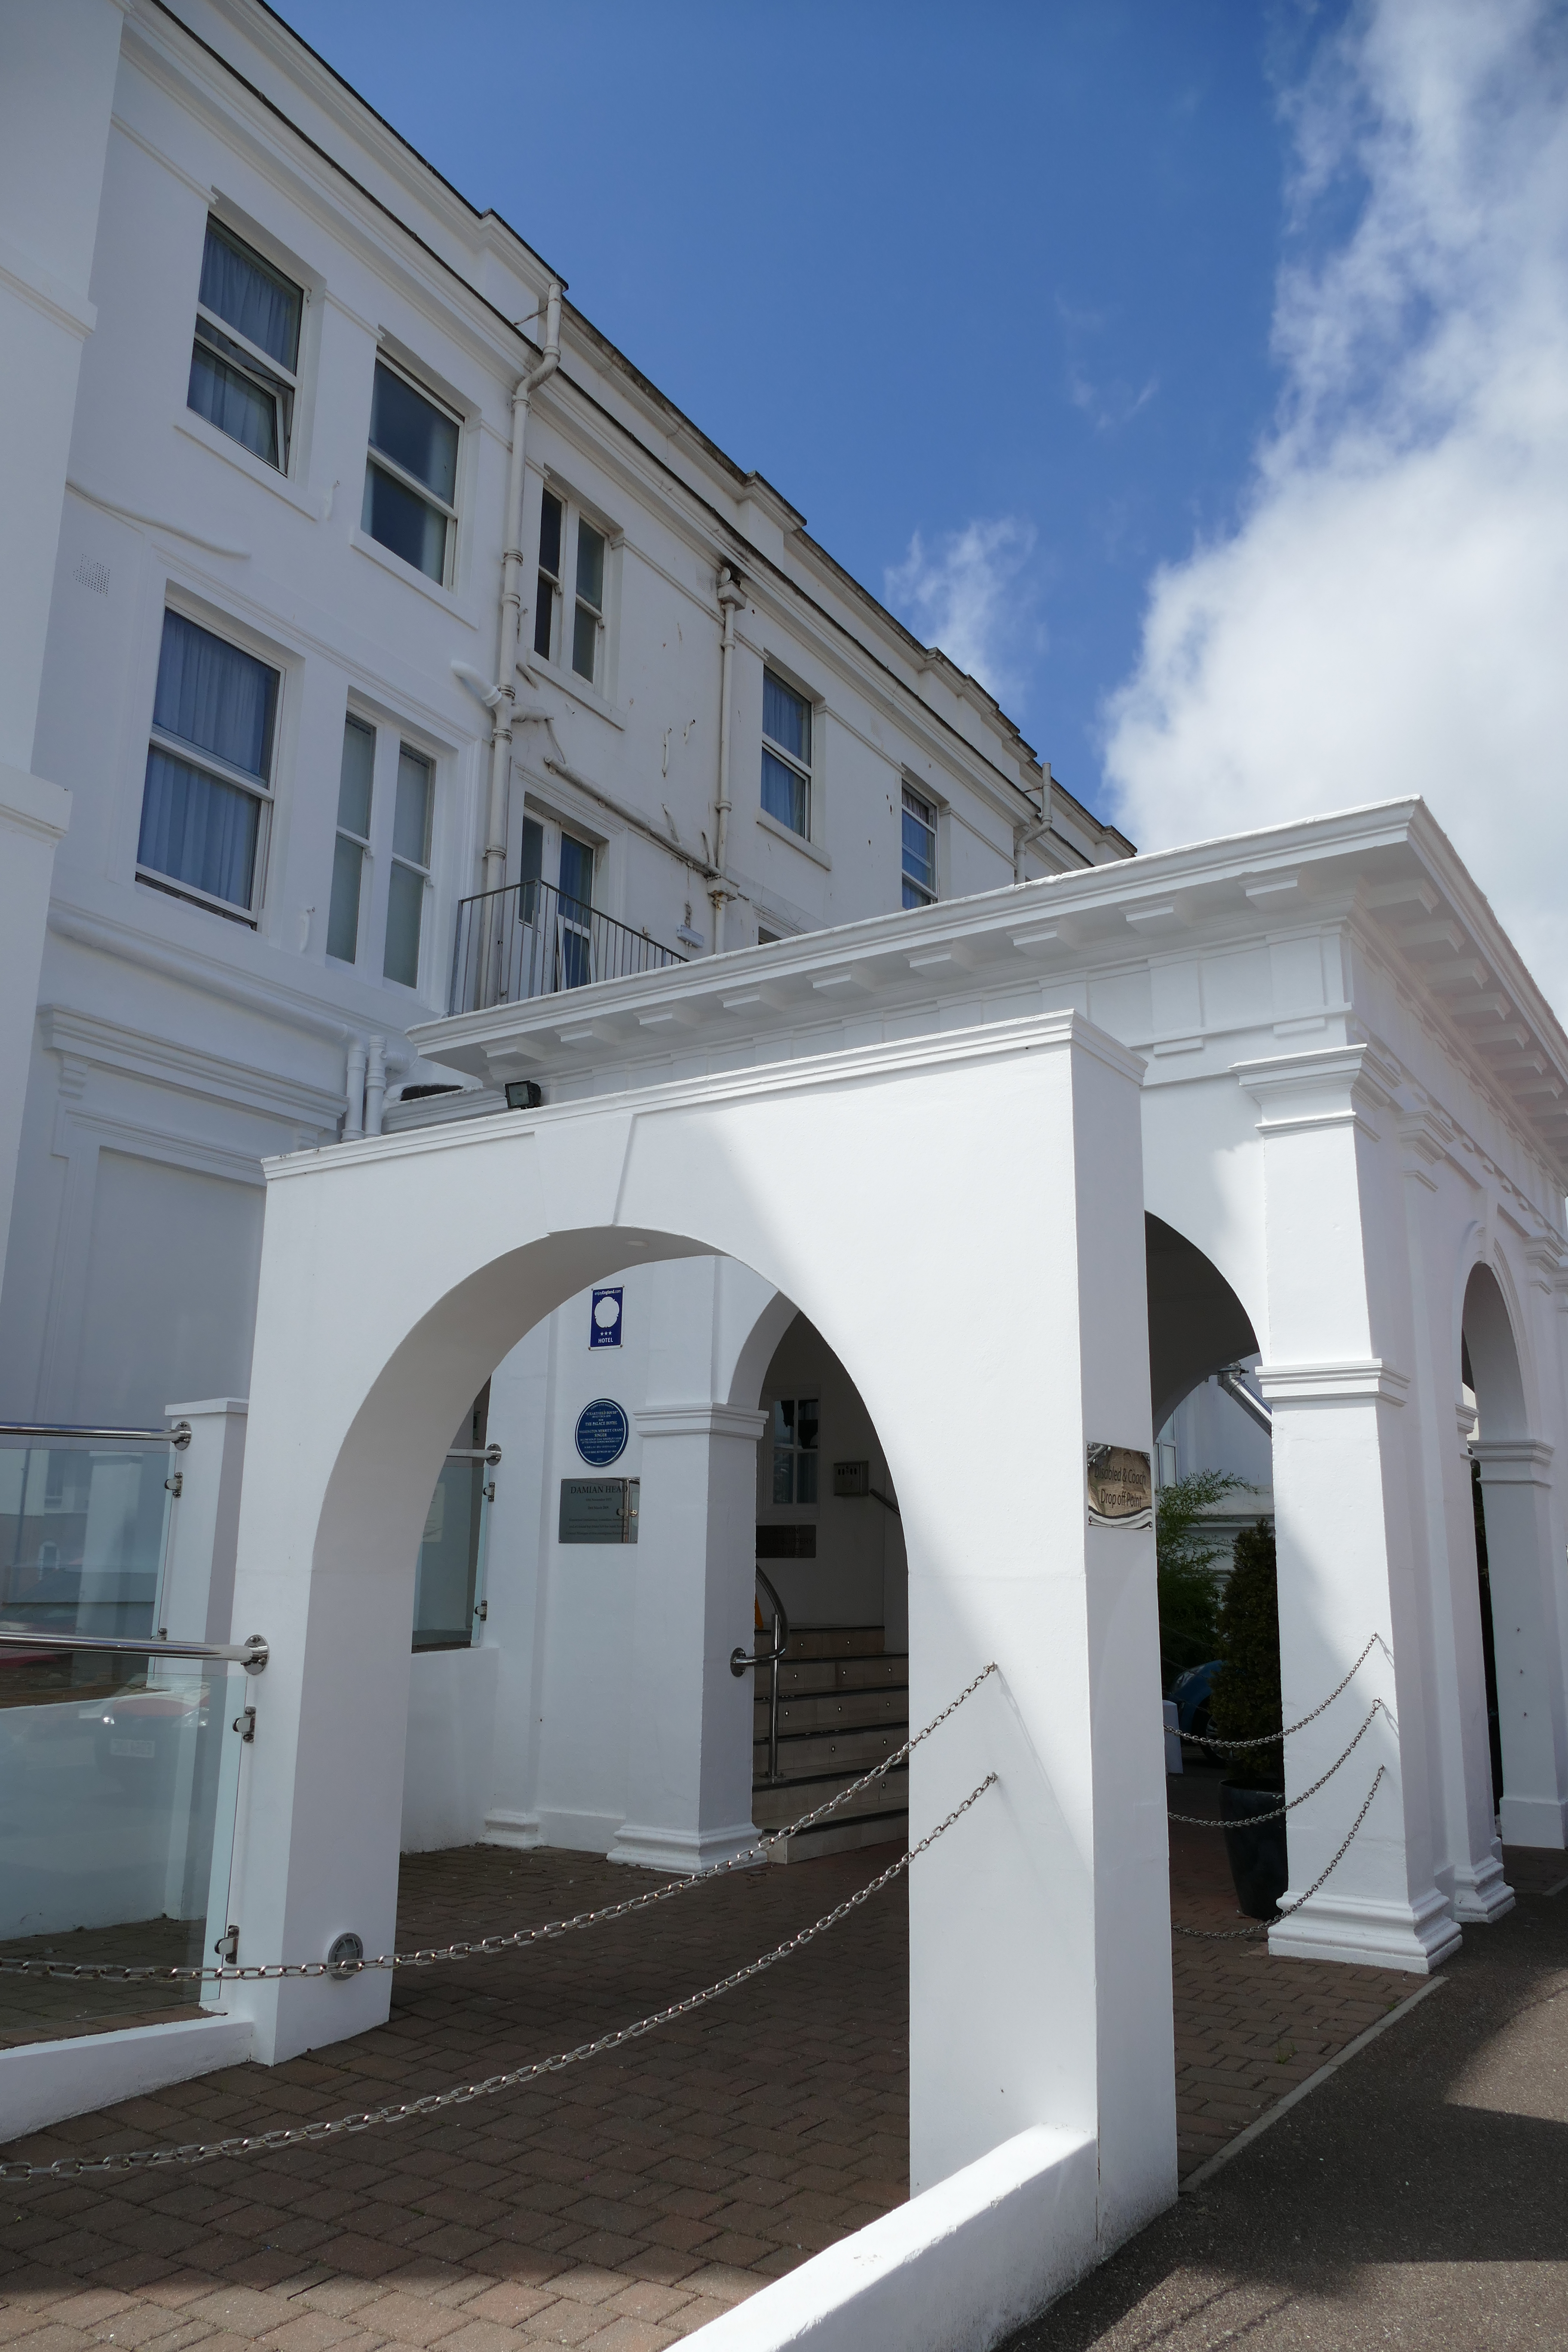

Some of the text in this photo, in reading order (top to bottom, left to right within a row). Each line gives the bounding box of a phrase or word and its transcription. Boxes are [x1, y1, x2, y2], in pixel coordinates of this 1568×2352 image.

[1094, 1465, 1146, 1485] Disabled & Coach
[606, 1485, 628, 1493] HEAD
[1100, 1488, 1142, 1508] Drop off Point
